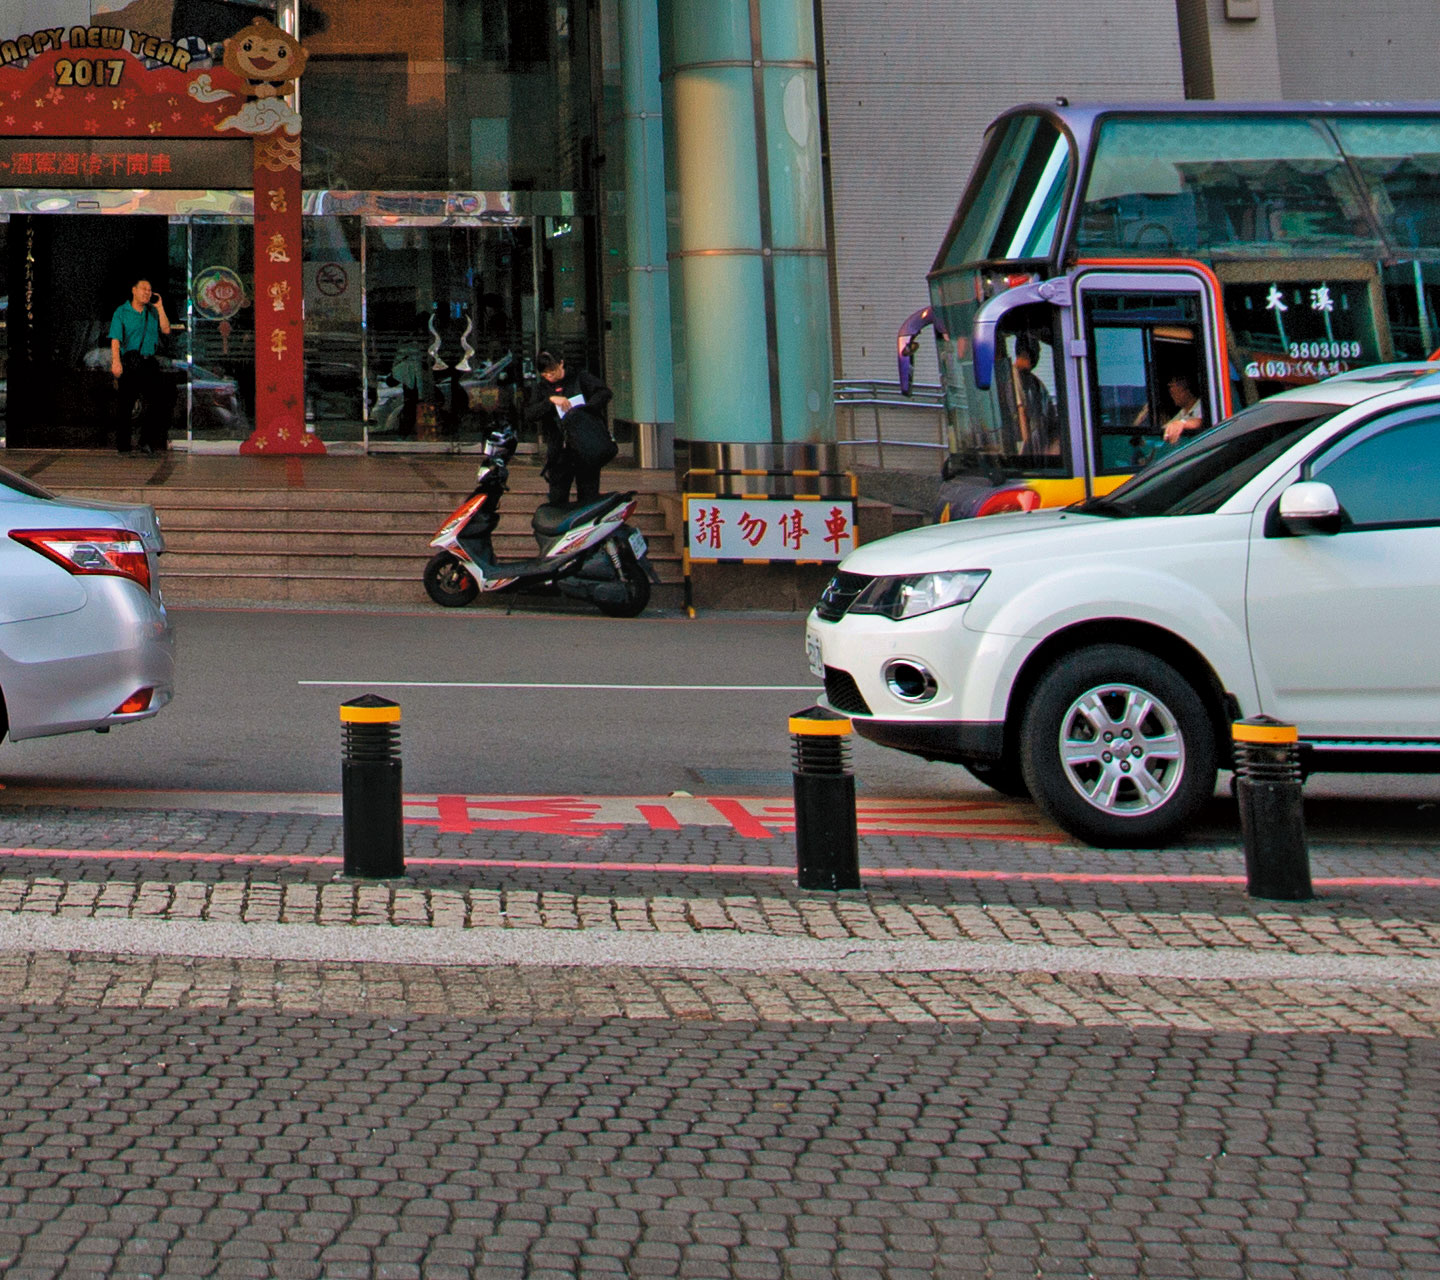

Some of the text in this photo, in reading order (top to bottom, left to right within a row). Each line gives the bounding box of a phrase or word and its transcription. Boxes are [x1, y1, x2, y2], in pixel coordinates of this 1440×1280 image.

[70, 25, 125, 49] NEW
[128, 31, 192, 72] YEAR
[54, 58, 126, 87] 2017
[1265, 286, 1334, 312] 大溪
[1290, 342, 1361, 358] 3803089
[695, 506, 851, 554] 請勿停車
